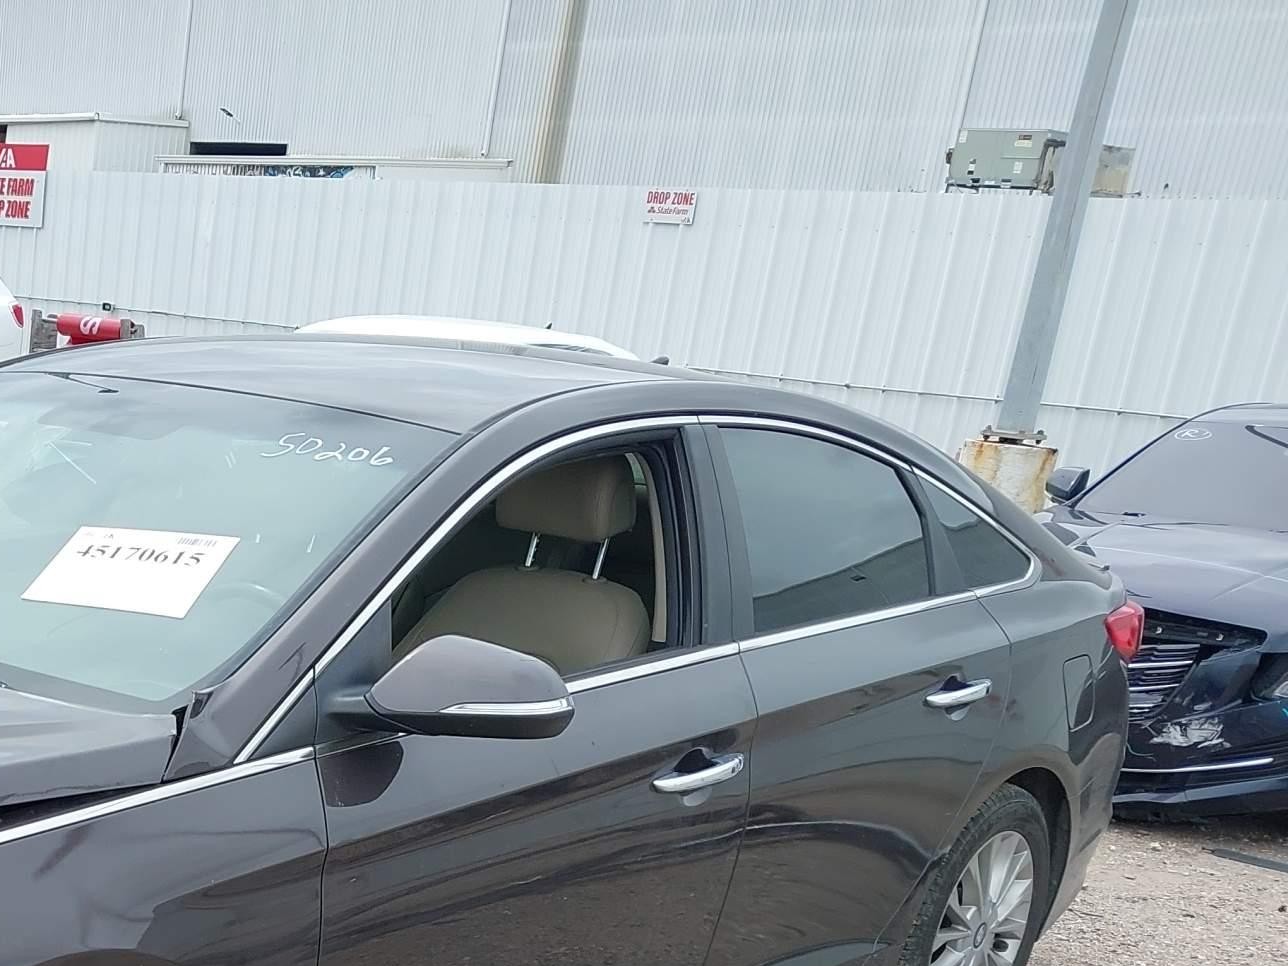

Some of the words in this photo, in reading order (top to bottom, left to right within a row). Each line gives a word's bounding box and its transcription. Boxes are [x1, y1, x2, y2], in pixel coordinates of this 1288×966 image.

[7, 178, 35, 197] FARM
[647, 191, 671, 205] DROP
[671, 191, 696, 206] ZONE
[5, 200, 32, 219] ZONE
[656, 206, 672, 215] State
[673, 207, 689, 216] Farm
[76, 544, 206, 567] 45170615
